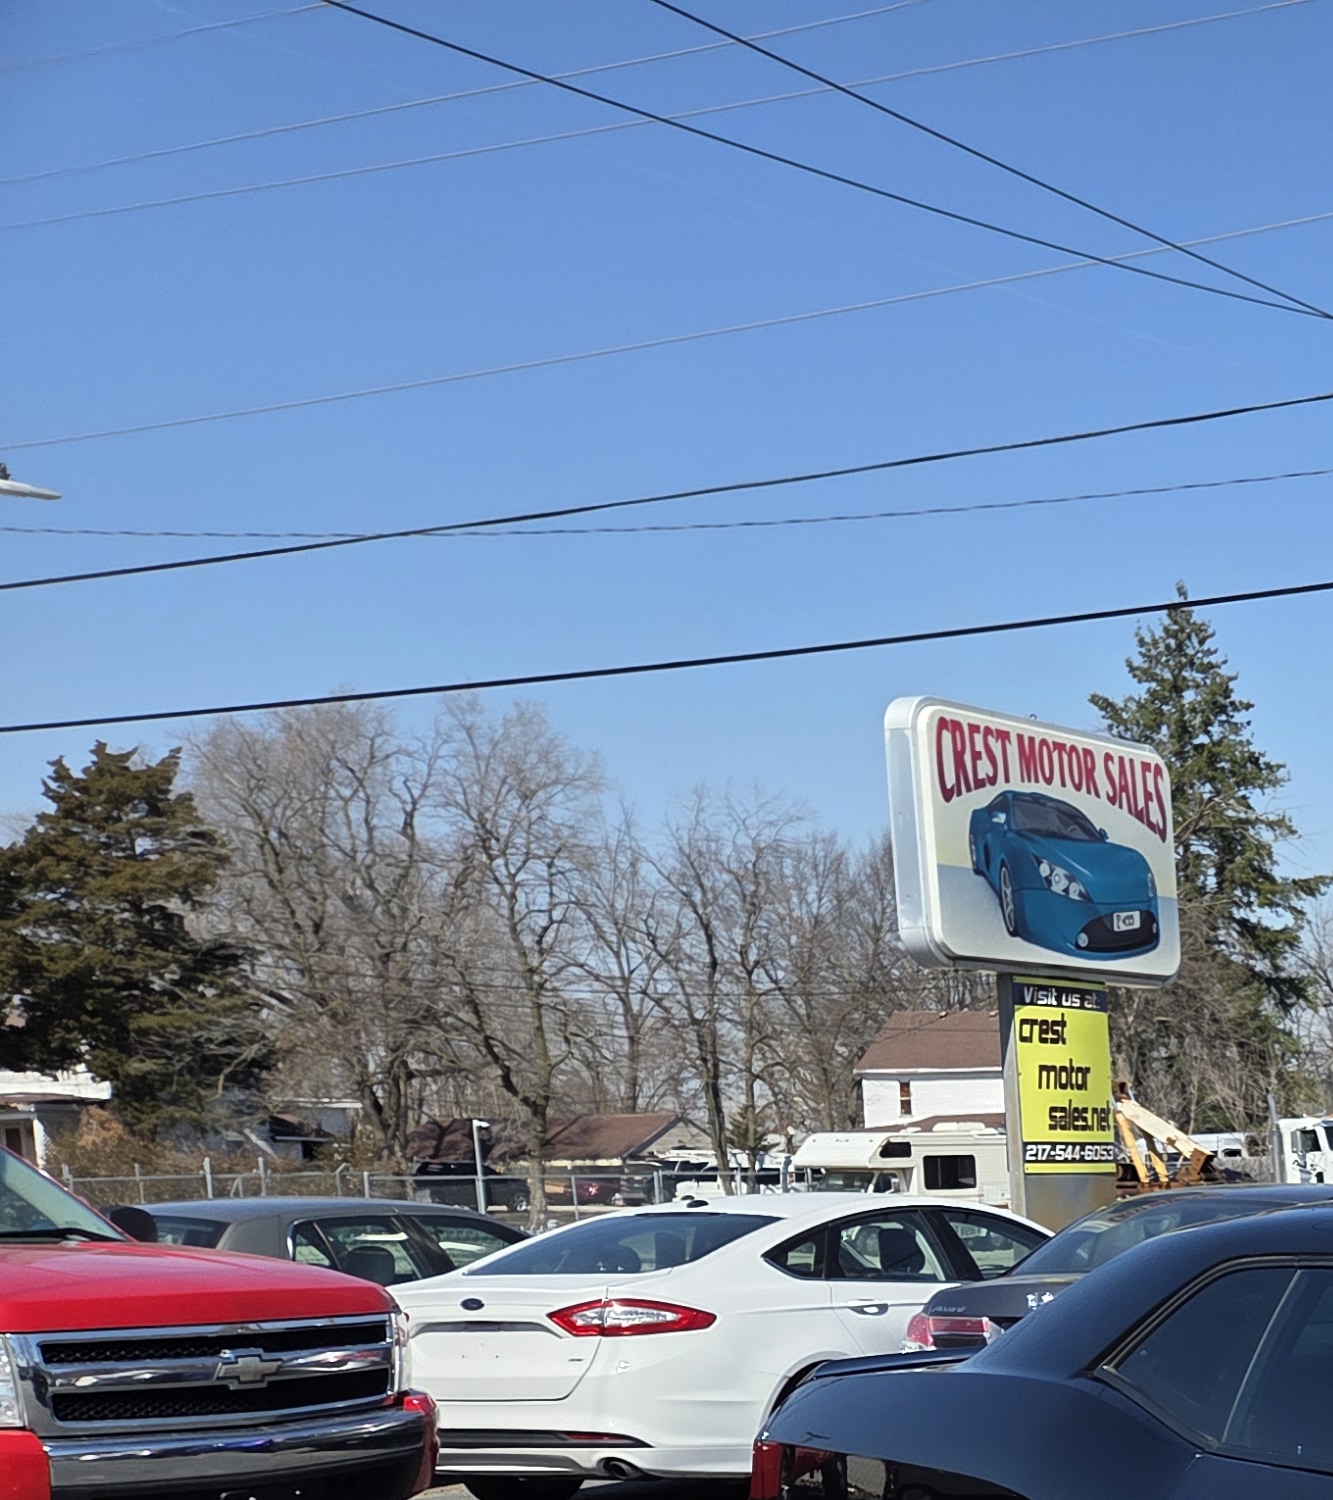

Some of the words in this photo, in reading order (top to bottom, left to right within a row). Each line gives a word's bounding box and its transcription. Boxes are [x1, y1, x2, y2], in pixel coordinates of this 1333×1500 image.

[936, 716, 1012, 803] CREST
[1016, 733, 1101, 799] MOTOR
[1104, 752, 1168, 843] SALES
[1023, 986, 1058, 1006] Visit
[1061, 993, 1081, 1007] us
[1019, 1012, 1067, 1045] crest
[1038, 1058, 1091, 1091] motor
[1048, 1099, 1111, 1132] sales.net
[1025, 1144, 1114, 1161] 217-544-6053
